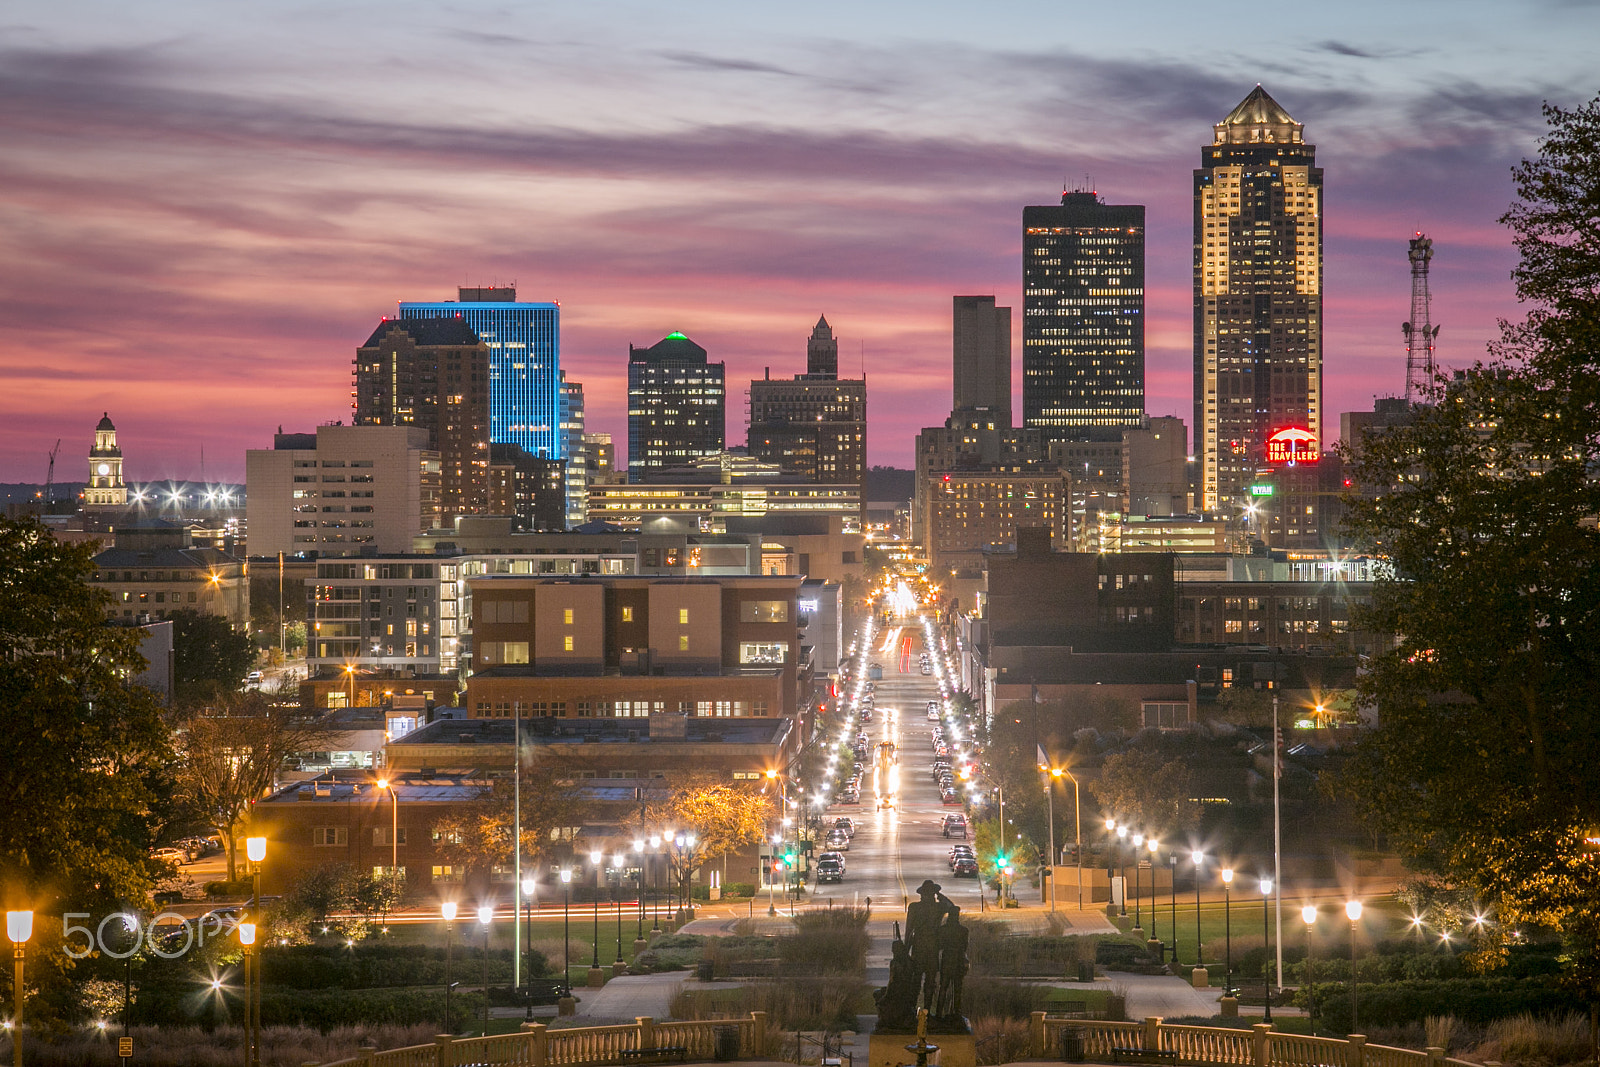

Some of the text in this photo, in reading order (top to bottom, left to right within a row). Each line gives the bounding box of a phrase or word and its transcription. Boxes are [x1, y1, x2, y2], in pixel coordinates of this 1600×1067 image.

[1269, 443, 1286, 452] THE
[1269, 451, 1318, 461] TRAVELERS
[1252, 486, 1273, 495] RYAN
